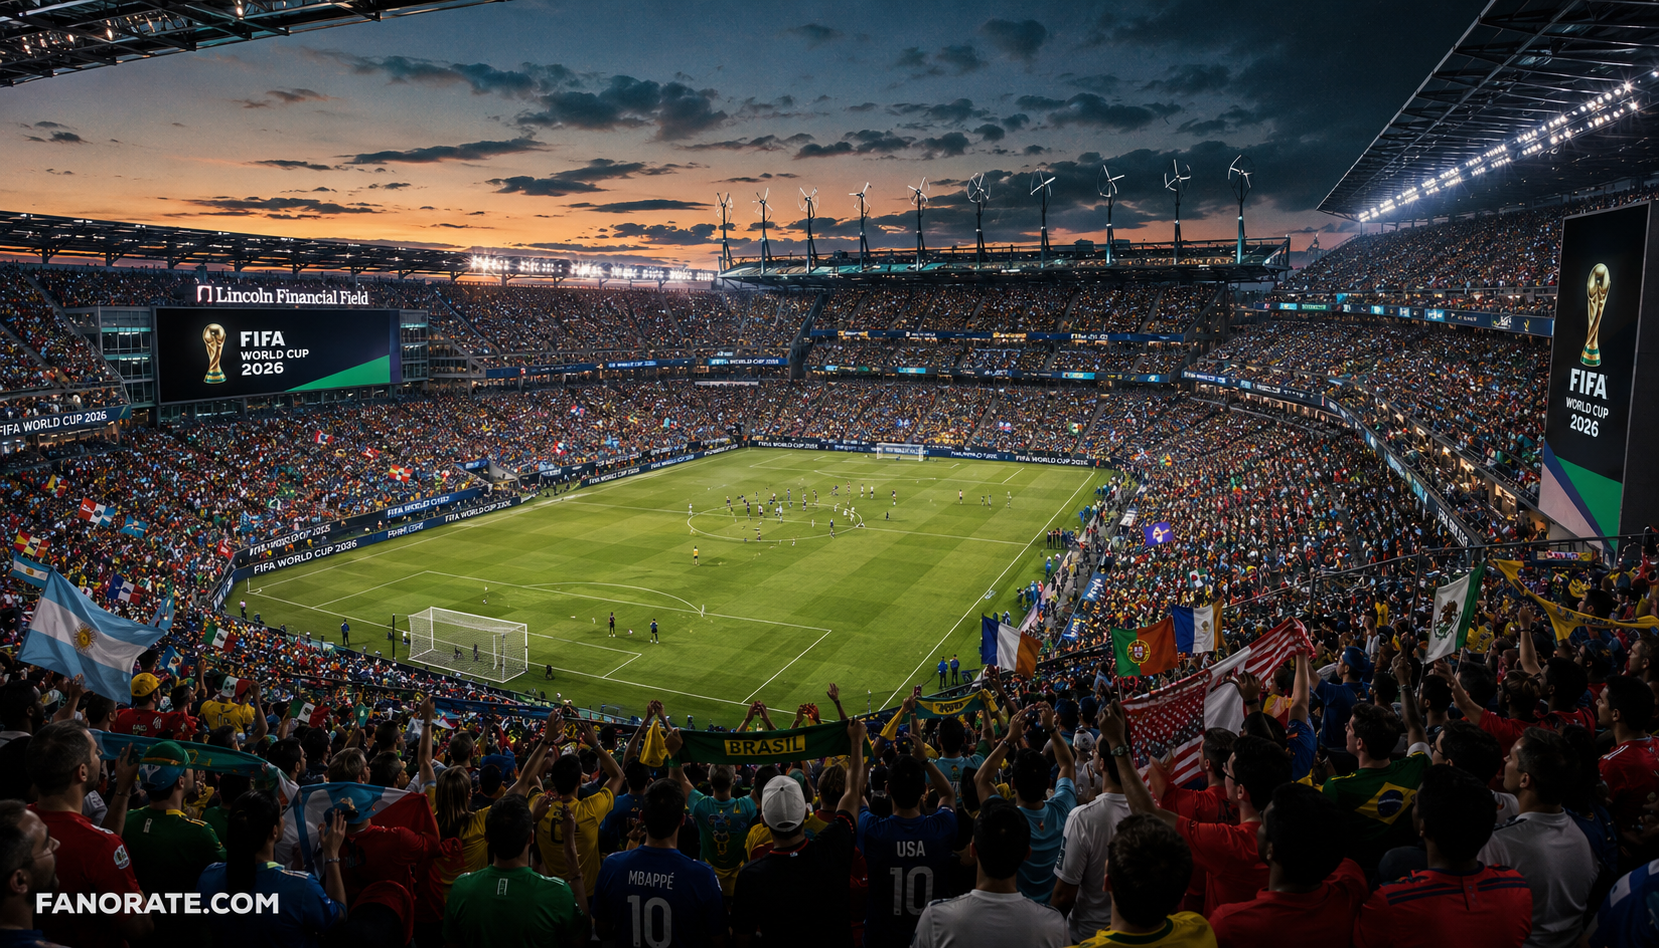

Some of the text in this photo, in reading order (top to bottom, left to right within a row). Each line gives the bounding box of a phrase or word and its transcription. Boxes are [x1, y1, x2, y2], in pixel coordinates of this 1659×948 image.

[215, 286, 369, 305] Lincoln Financial Field
[240, 330, 286, 348] FIFA
[240, 349, 309, 361] WORLD CUP
[241, 362, 284, 376] 2026
[1569, 367, 1608, 400] FIFA
[1565, 396, 1609, 419] WORLD CUP
[23, 417, 60, 432] WORLD
[62, 414, 83, 426] CUP
[84, 410, 108, 423] 2026
[1569, 413, 1599, 438] 2026
[254, 562, 276, 575] FIFA
[277, 551, 313, 568] WORLD
[314, 545, 334, 559] CUP
[729, 736, 803, 755] BRASIL
[896, 840, 926, 858] USA
[627, 869, 676, 891] MBAPPÉ
[889, 865, 935, 916] 10
[626, 894, 673, 948] 10
